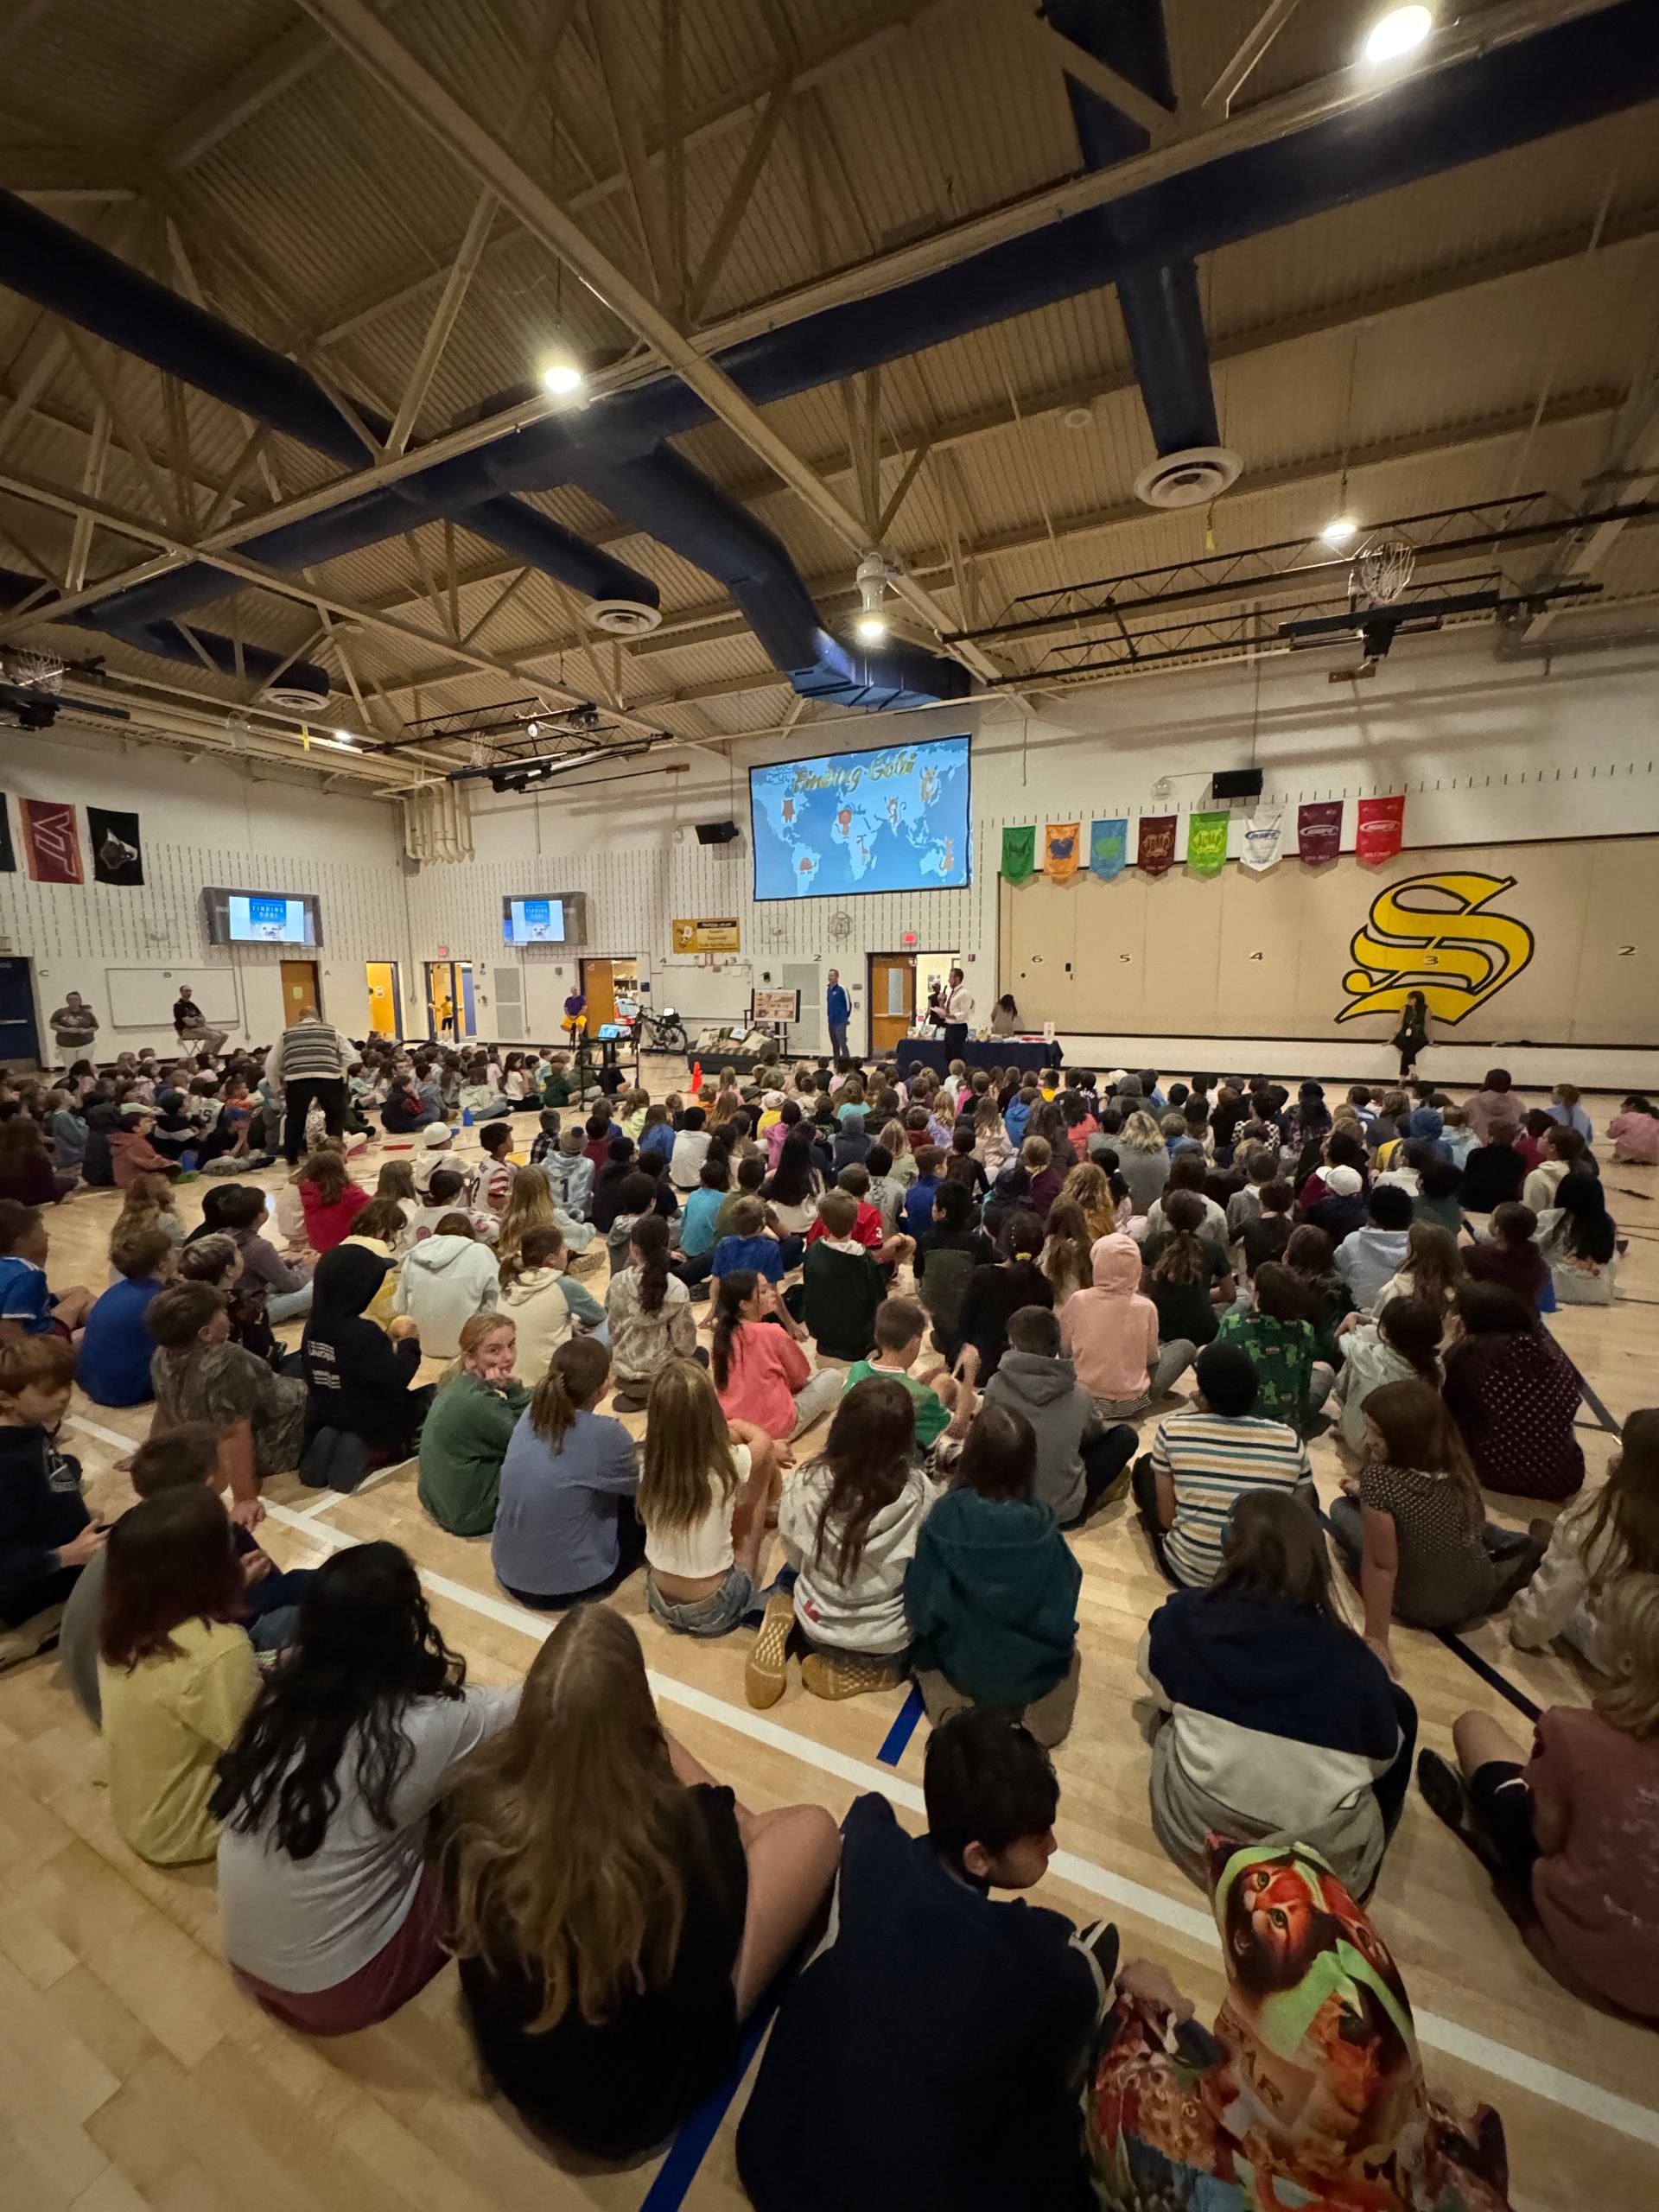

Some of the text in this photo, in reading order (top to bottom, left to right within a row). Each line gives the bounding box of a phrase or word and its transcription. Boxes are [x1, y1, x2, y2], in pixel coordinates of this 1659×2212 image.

[793, 750, 918, 792] Finding Gobi
[1618, 945, 1636, 956] 2
[1119, 954, 1131, 963] 5
[1249, 951, 1263, 961] 4
[1424, 956, 1439, 965] 3
[560, 1178, 569, 1203] 1
